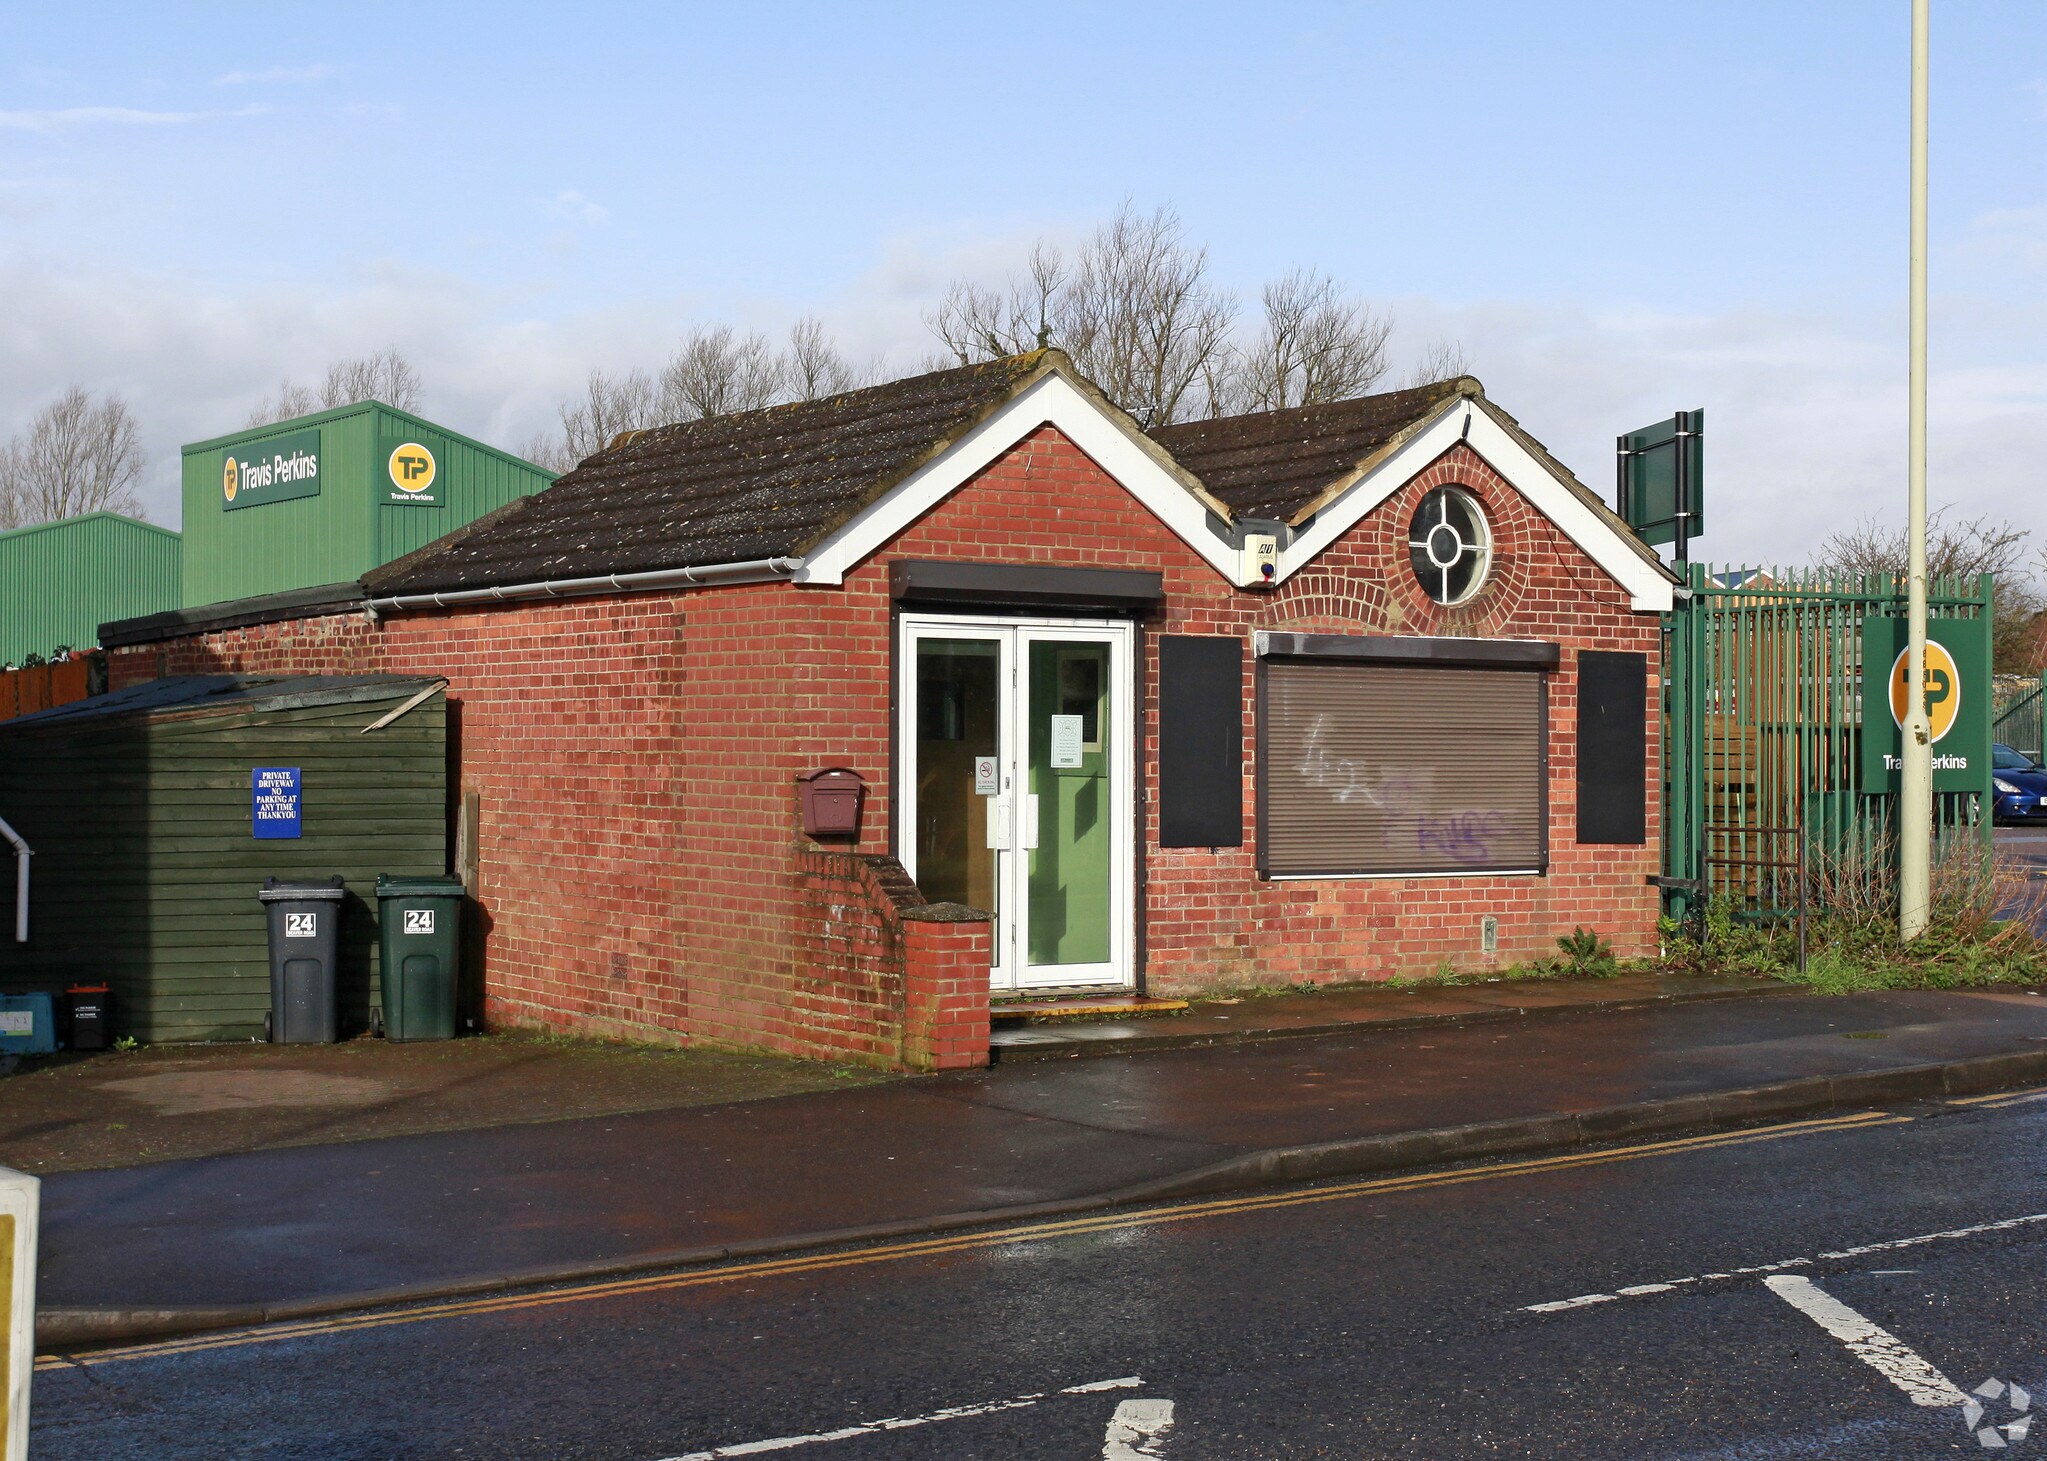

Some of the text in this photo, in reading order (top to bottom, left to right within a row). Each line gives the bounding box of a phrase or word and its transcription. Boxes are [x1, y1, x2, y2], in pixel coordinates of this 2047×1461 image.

[240, 449, 317, 490] Travis Perkins
[398, 456, 428, 479] TP
[390, 492, 434, 501] Travis Perkins
[1903, 669, 1950, 717] P
[1932, 753, 1967, 770] erkins
[258, 780, 295, 788] DRIVEWAY
[288, 795, 297, 803] AT
[276, 803, 294, 811] TIME
[257, 811, 297, 819] THANKYOU
[289, 915, 313, 930] 24
[408, 912, 431, 928] 24
